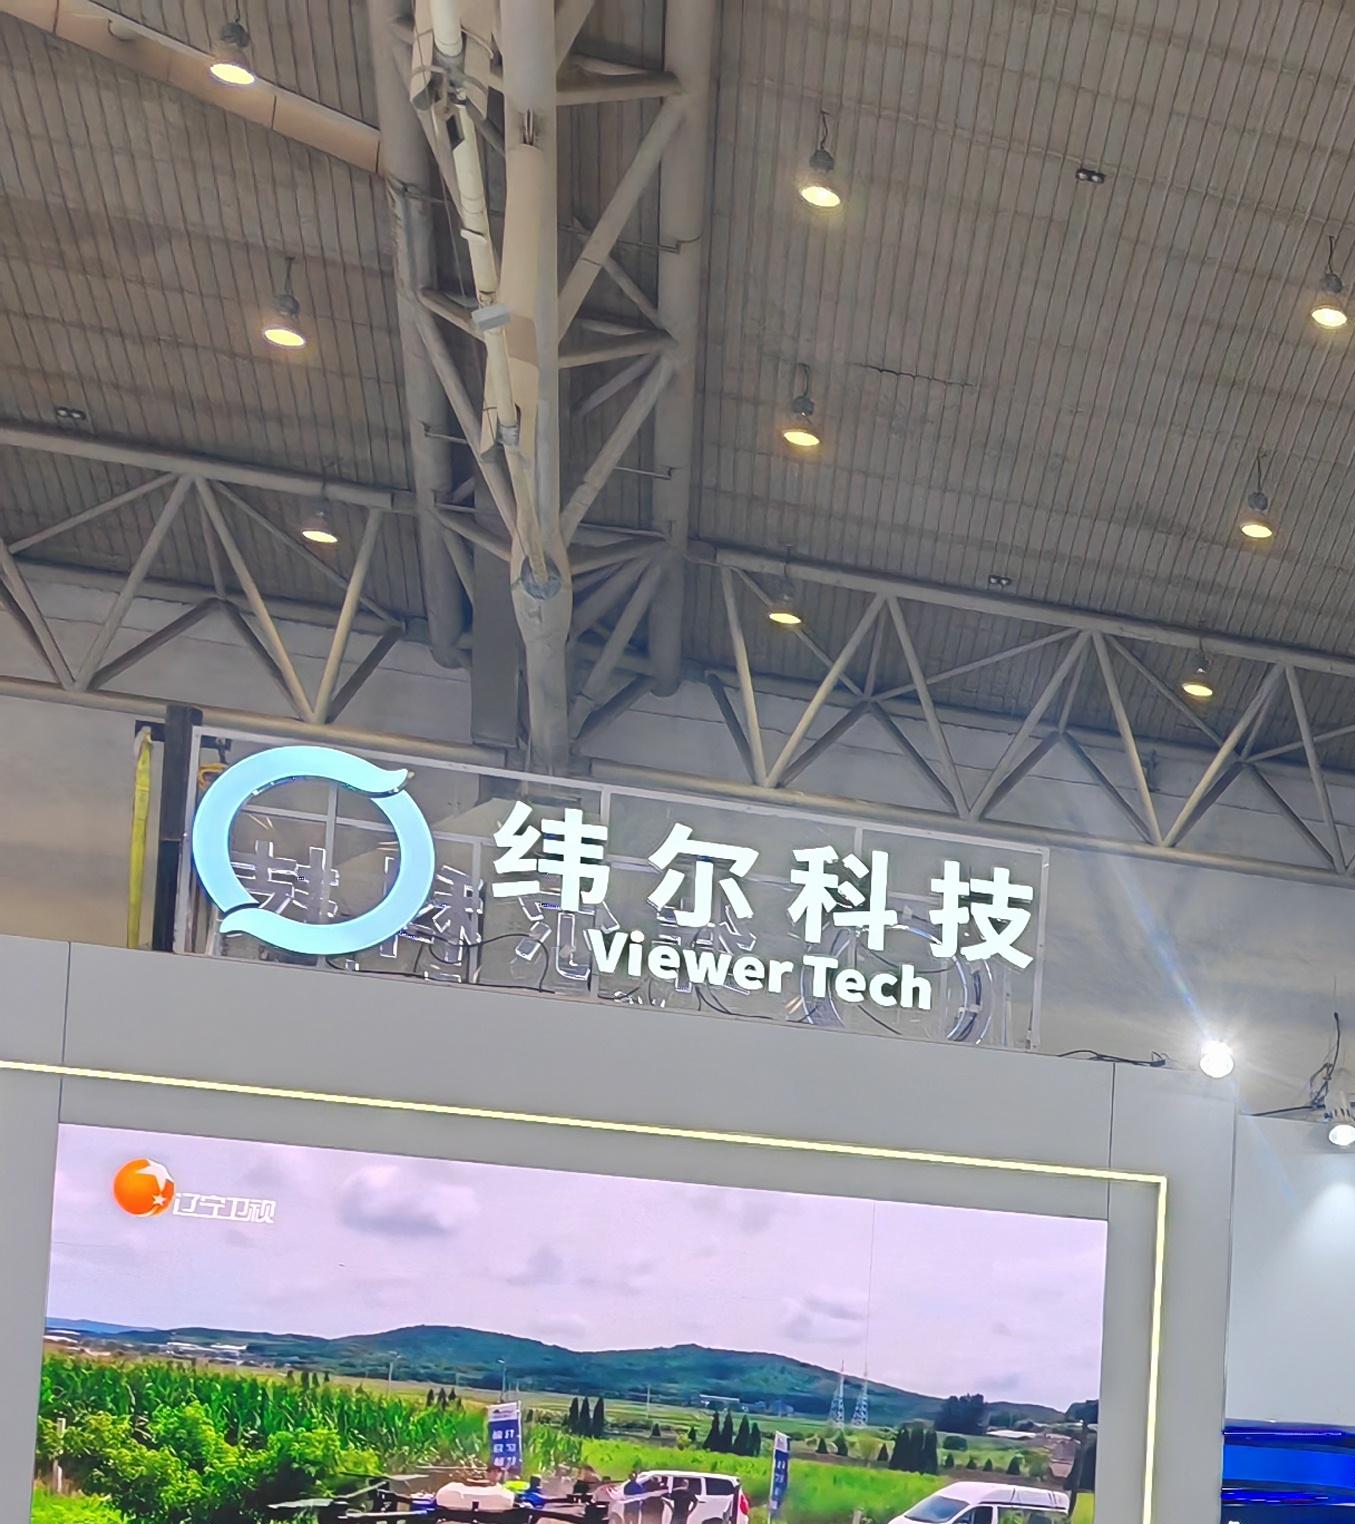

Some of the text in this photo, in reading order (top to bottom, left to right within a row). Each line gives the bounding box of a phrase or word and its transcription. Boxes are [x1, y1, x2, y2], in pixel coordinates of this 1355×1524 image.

[491, 800, 1034, 970] 纬尔科技
[588, 928, 932, 1010] Viewer Tech
[171, 1191, 277, 1224] 辽宁卫视
